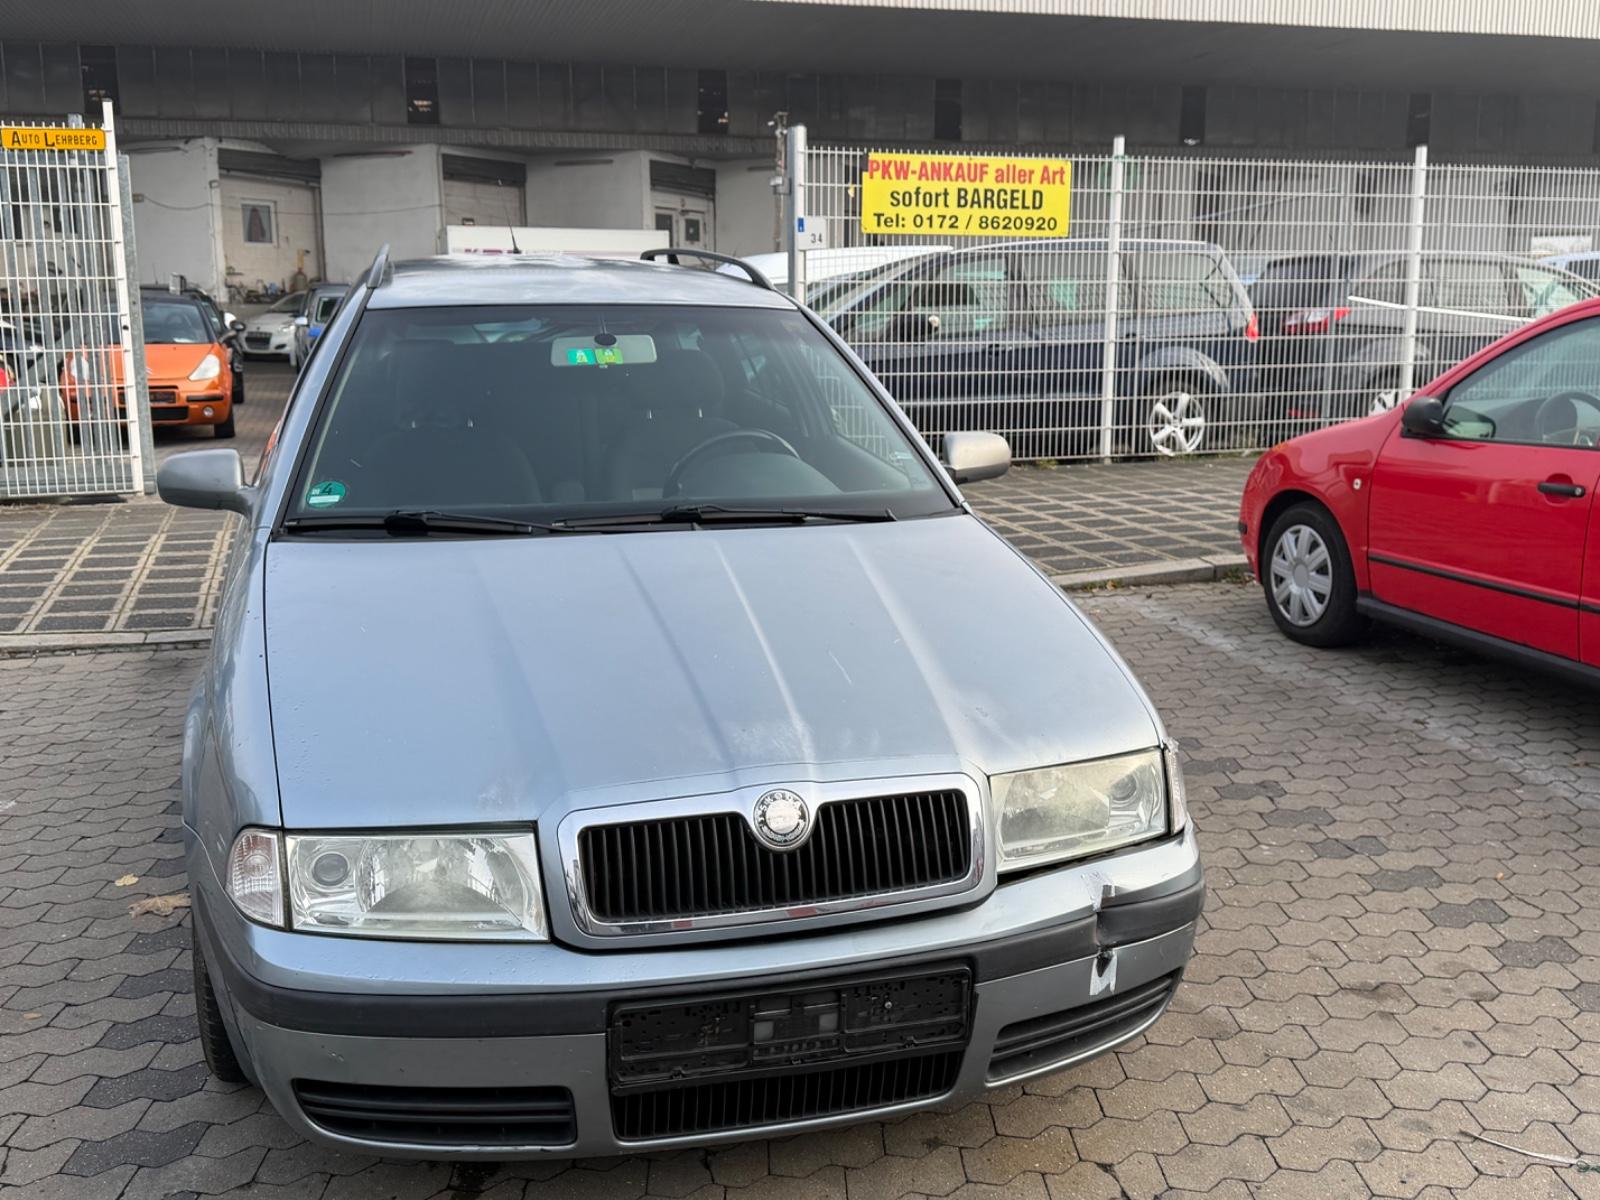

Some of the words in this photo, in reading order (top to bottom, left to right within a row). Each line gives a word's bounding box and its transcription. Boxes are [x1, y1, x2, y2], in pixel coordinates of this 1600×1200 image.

[868, 159, 989, 183] PKW-ANKAUF
[994, 165, 1035, 185] aller
[1040, 165, 1066, 185] Art
[890, 186, 950, 208] sofort
[956, 188, 1044, 211] BARGELD
[873, 213, 906, 229] Tel:
[912, 214, 960, 230] 0172
[965, 215, 973, 231] /
[978, 215, 1058, 231] 8620920
